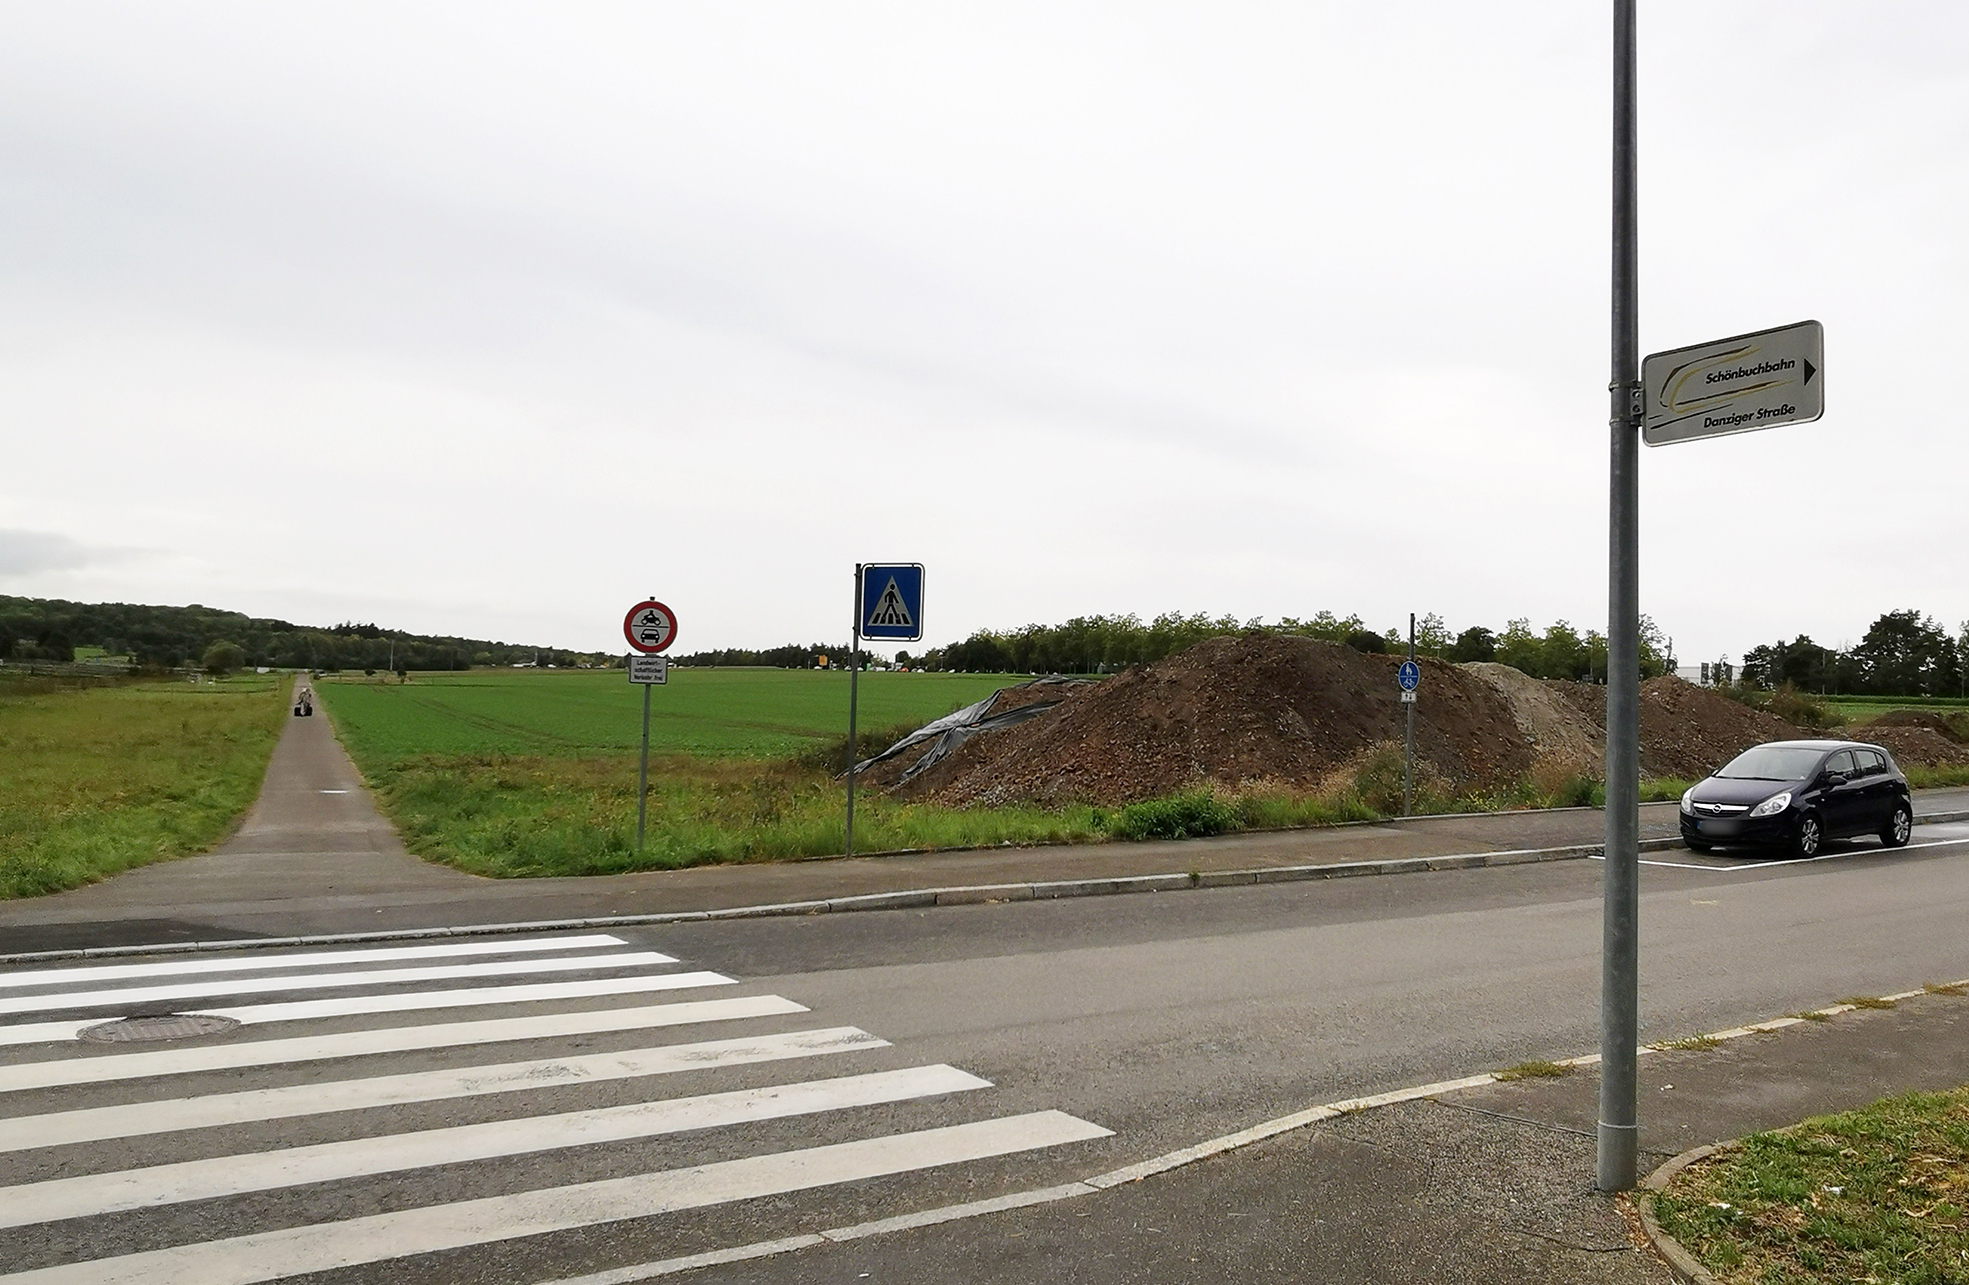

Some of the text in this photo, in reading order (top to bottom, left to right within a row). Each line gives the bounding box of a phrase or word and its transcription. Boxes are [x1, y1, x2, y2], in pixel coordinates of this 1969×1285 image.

[1706, 359, 1795, 384] Schönbuchbahn
[1704, 404, 1796, 428] Danziger Straße
